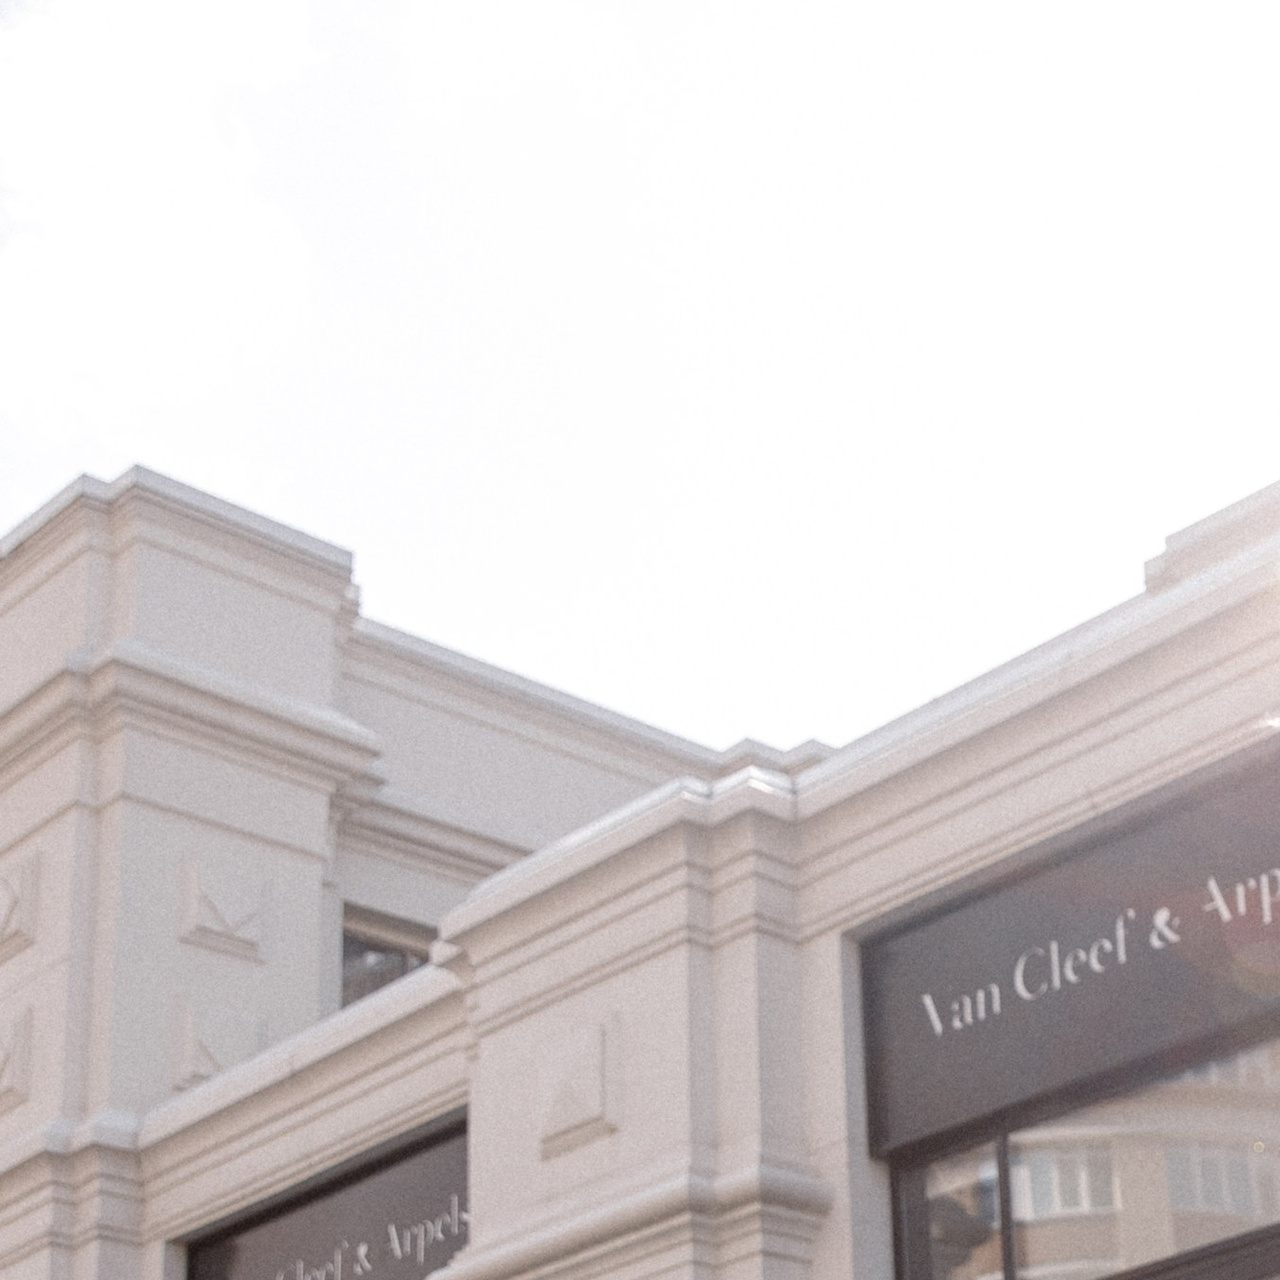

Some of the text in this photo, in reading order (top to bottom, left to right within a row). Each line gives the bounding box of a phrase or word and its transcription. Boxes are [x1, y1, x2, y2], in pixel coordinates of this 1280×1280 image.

[921, 982, 1002, 1037] Van
[1013, 907, 1137, 1001] Cleef
[1149, 905, 1181, 950] &
[352, 1241, 373, 1276] &
